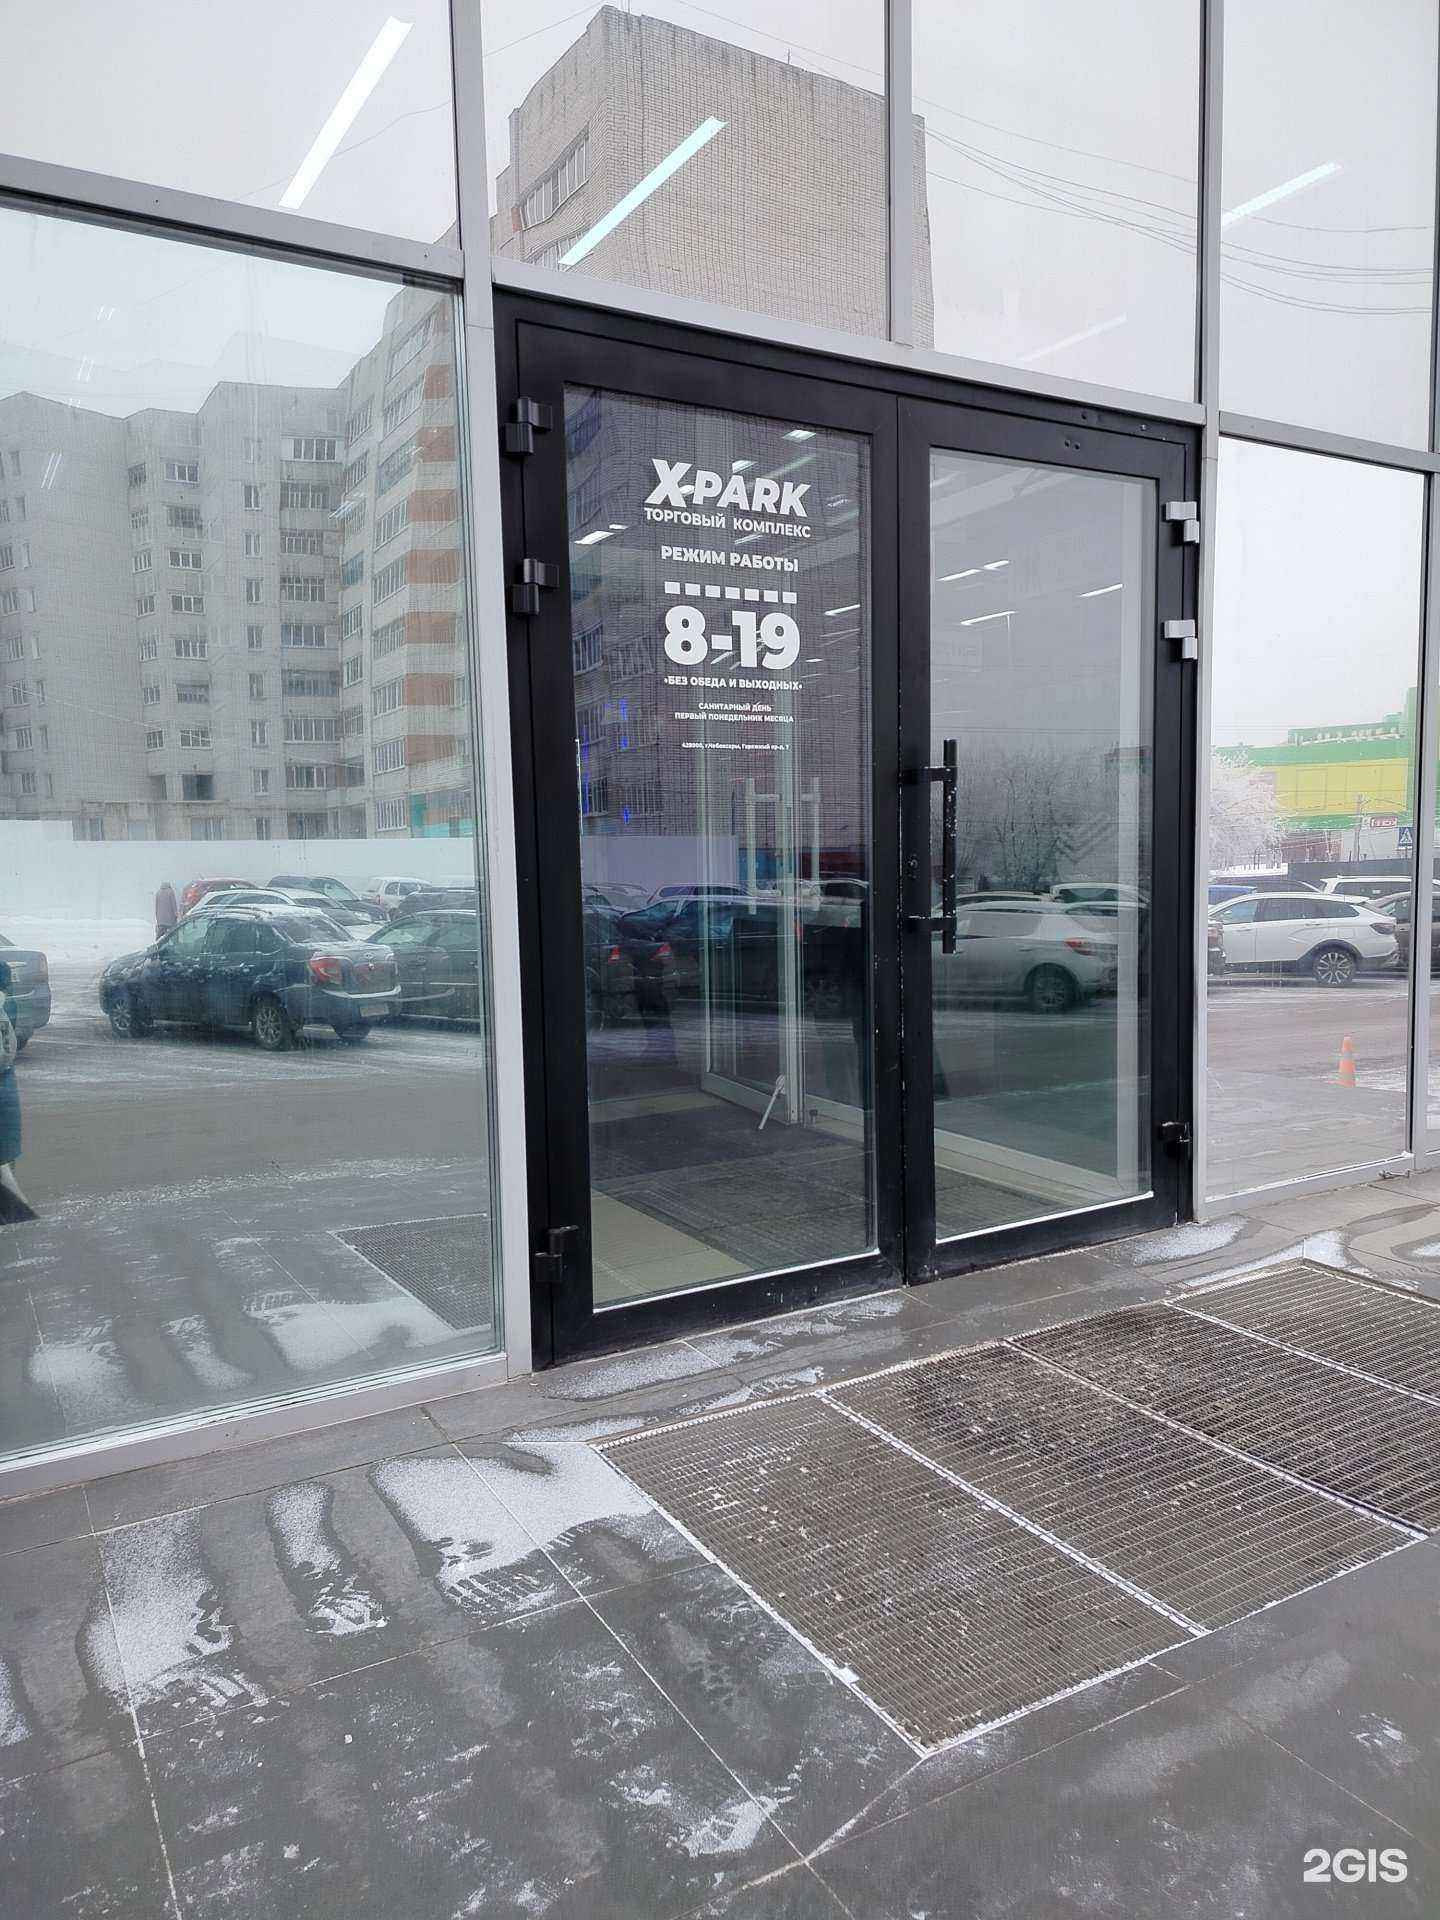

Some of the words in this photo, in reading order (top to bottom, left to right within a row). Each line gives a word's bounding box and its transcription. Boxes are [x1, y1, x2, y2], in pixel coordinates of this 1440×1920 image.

[644, 507, 726, 529] ТОРГОВЫЙ
[733, 517, 812, 538] КОМПЛЕКС
[661, 545, 726, 566] РЕЖИМ
[730, 552, 799, 573] РАБОТЫ
[664, 604, 801, 671] 8-19
[690, 677, 727, 689] ОБЕДА
[729, 679, 737, 688] И
[674, 711, 707, 721] ПЕРВЫЙ
[708, 714, 763, 723] ПОНЕДЕЛЬНИК
[764, 716, 794, 724] МЕСЯЦА
[698, 702, 751, 712] САНИТАРНЫЙ
[752, 703, 772, 713] ДЕНЬ
